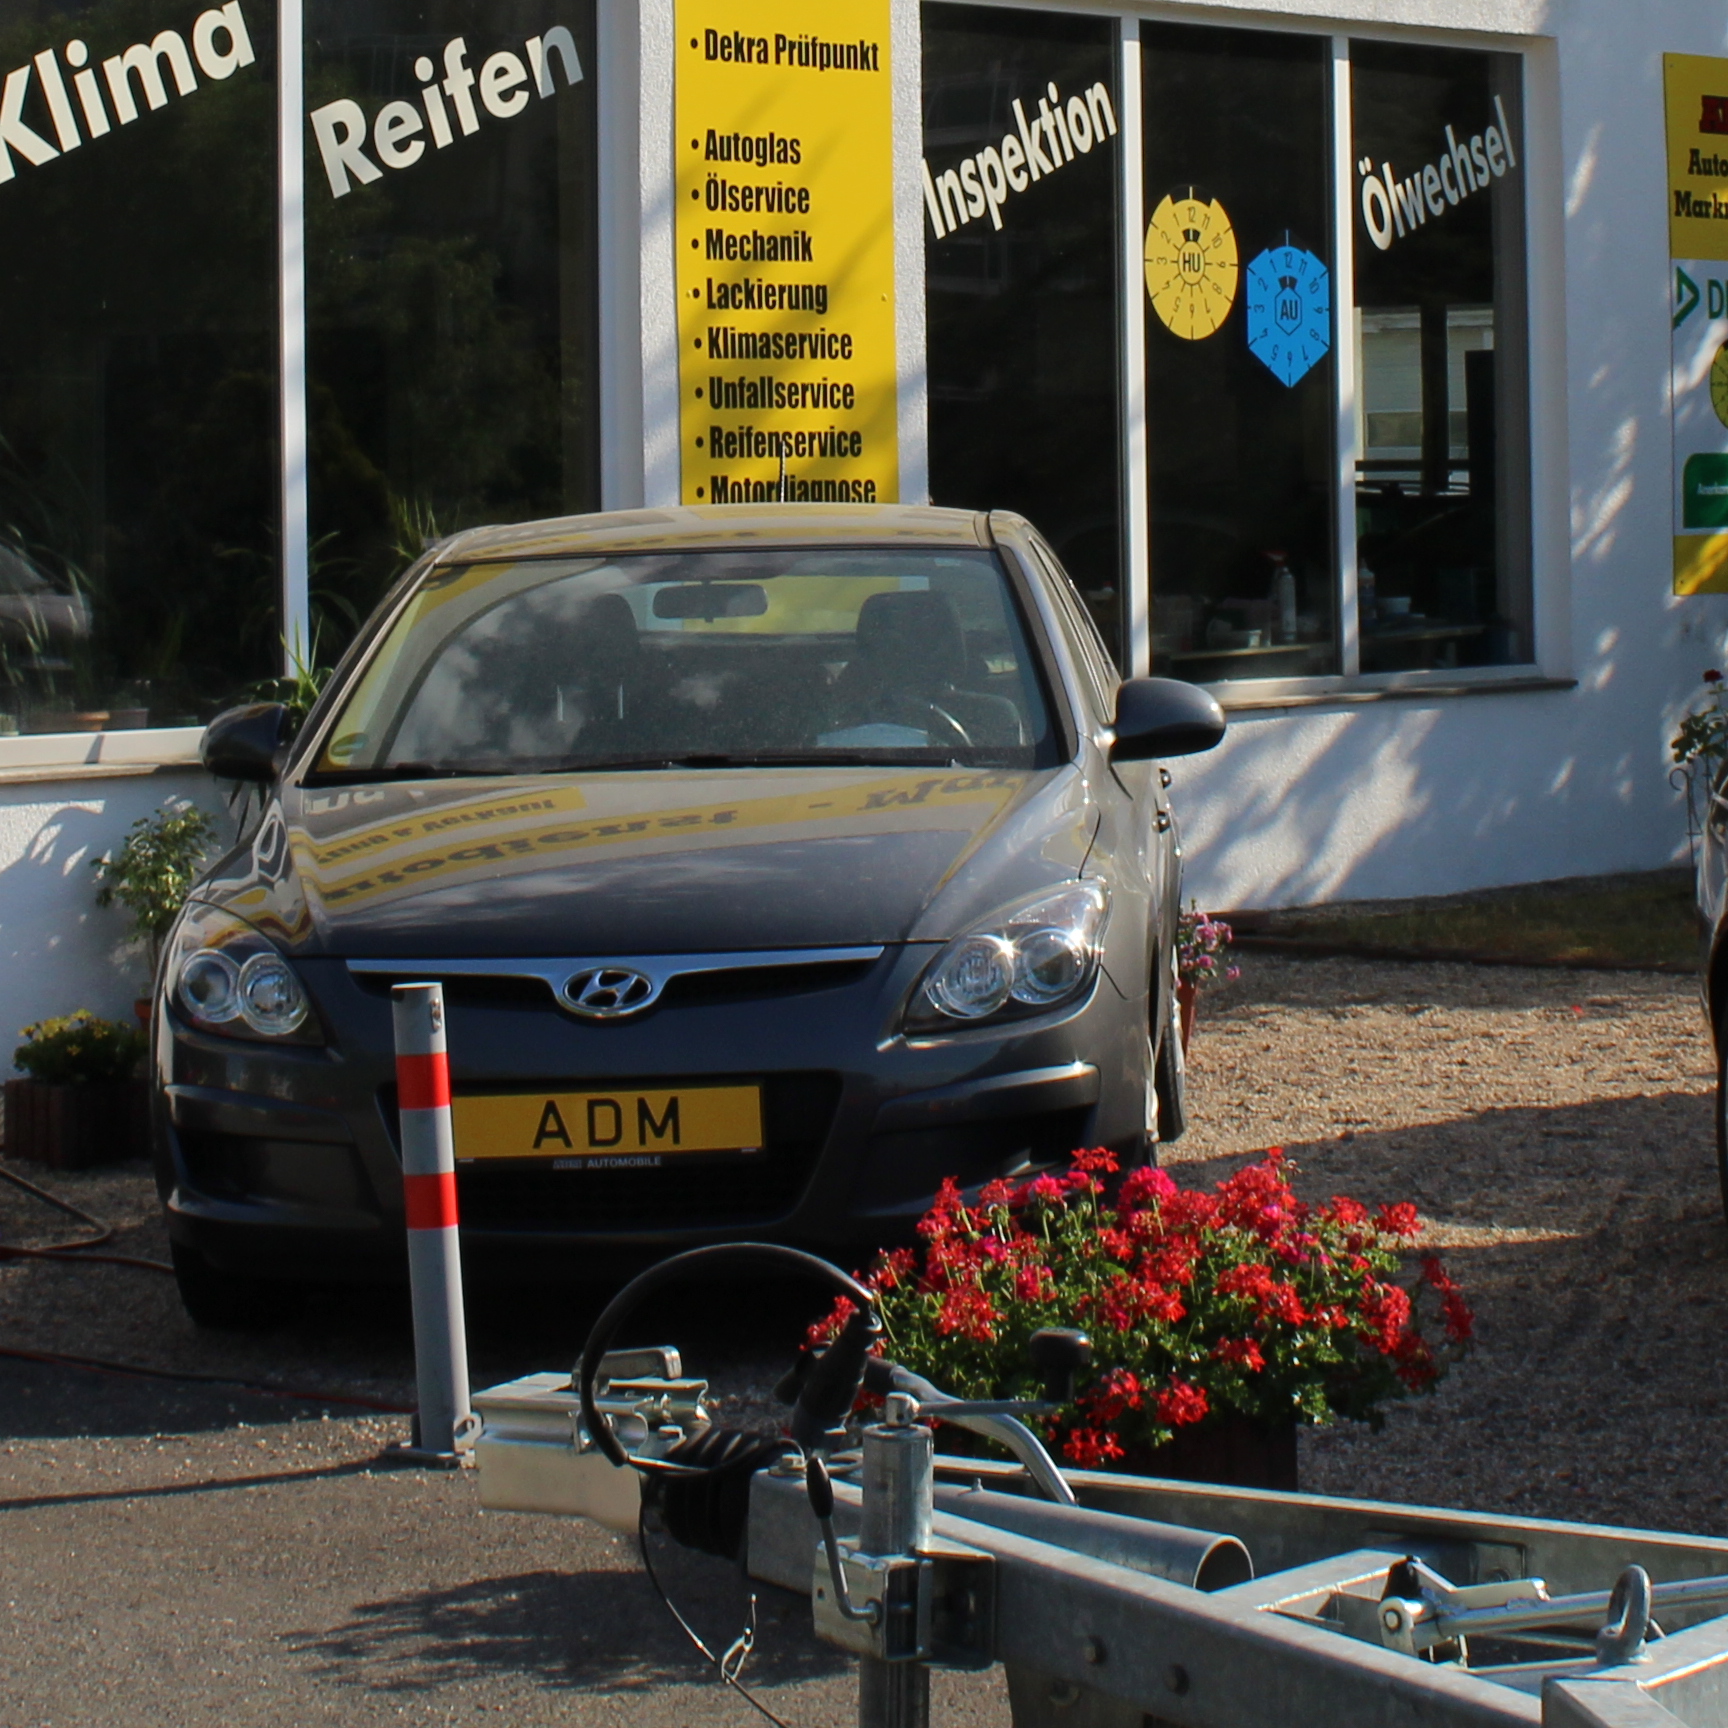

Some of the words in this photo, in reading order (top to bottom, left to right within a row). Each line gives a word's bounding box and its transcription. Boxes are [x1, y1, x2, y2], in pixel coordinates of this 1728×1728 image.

[705, 28, 769, 65] Dekra
[774, 33, 879, 72] Prüfpunkt
[310, 25, 583, 199] Reifen
[705, 129, 801, 167] Autoglas
[921, 80, 1118, 240] Inspektion
[1357, 95, 1516, 250] Ölwechsel
[706, 173, 810, 214] Ölservice
[705, 229, 813, 263] Mechanik
[1183, 252, 1201, 273] HU
[706, 278, 828, 315] Lackierung
[1280, 299, 1298, 321] AU
[708, 327, 853, 360] Klimaservice
[709, 376, 855, 410] Unfallservice
[710, 425, 862, 459] Reifenservice
[533, 1097, 681, 1149] ADM
[587, 1156, 662, 1168] AUTOMOBILE
